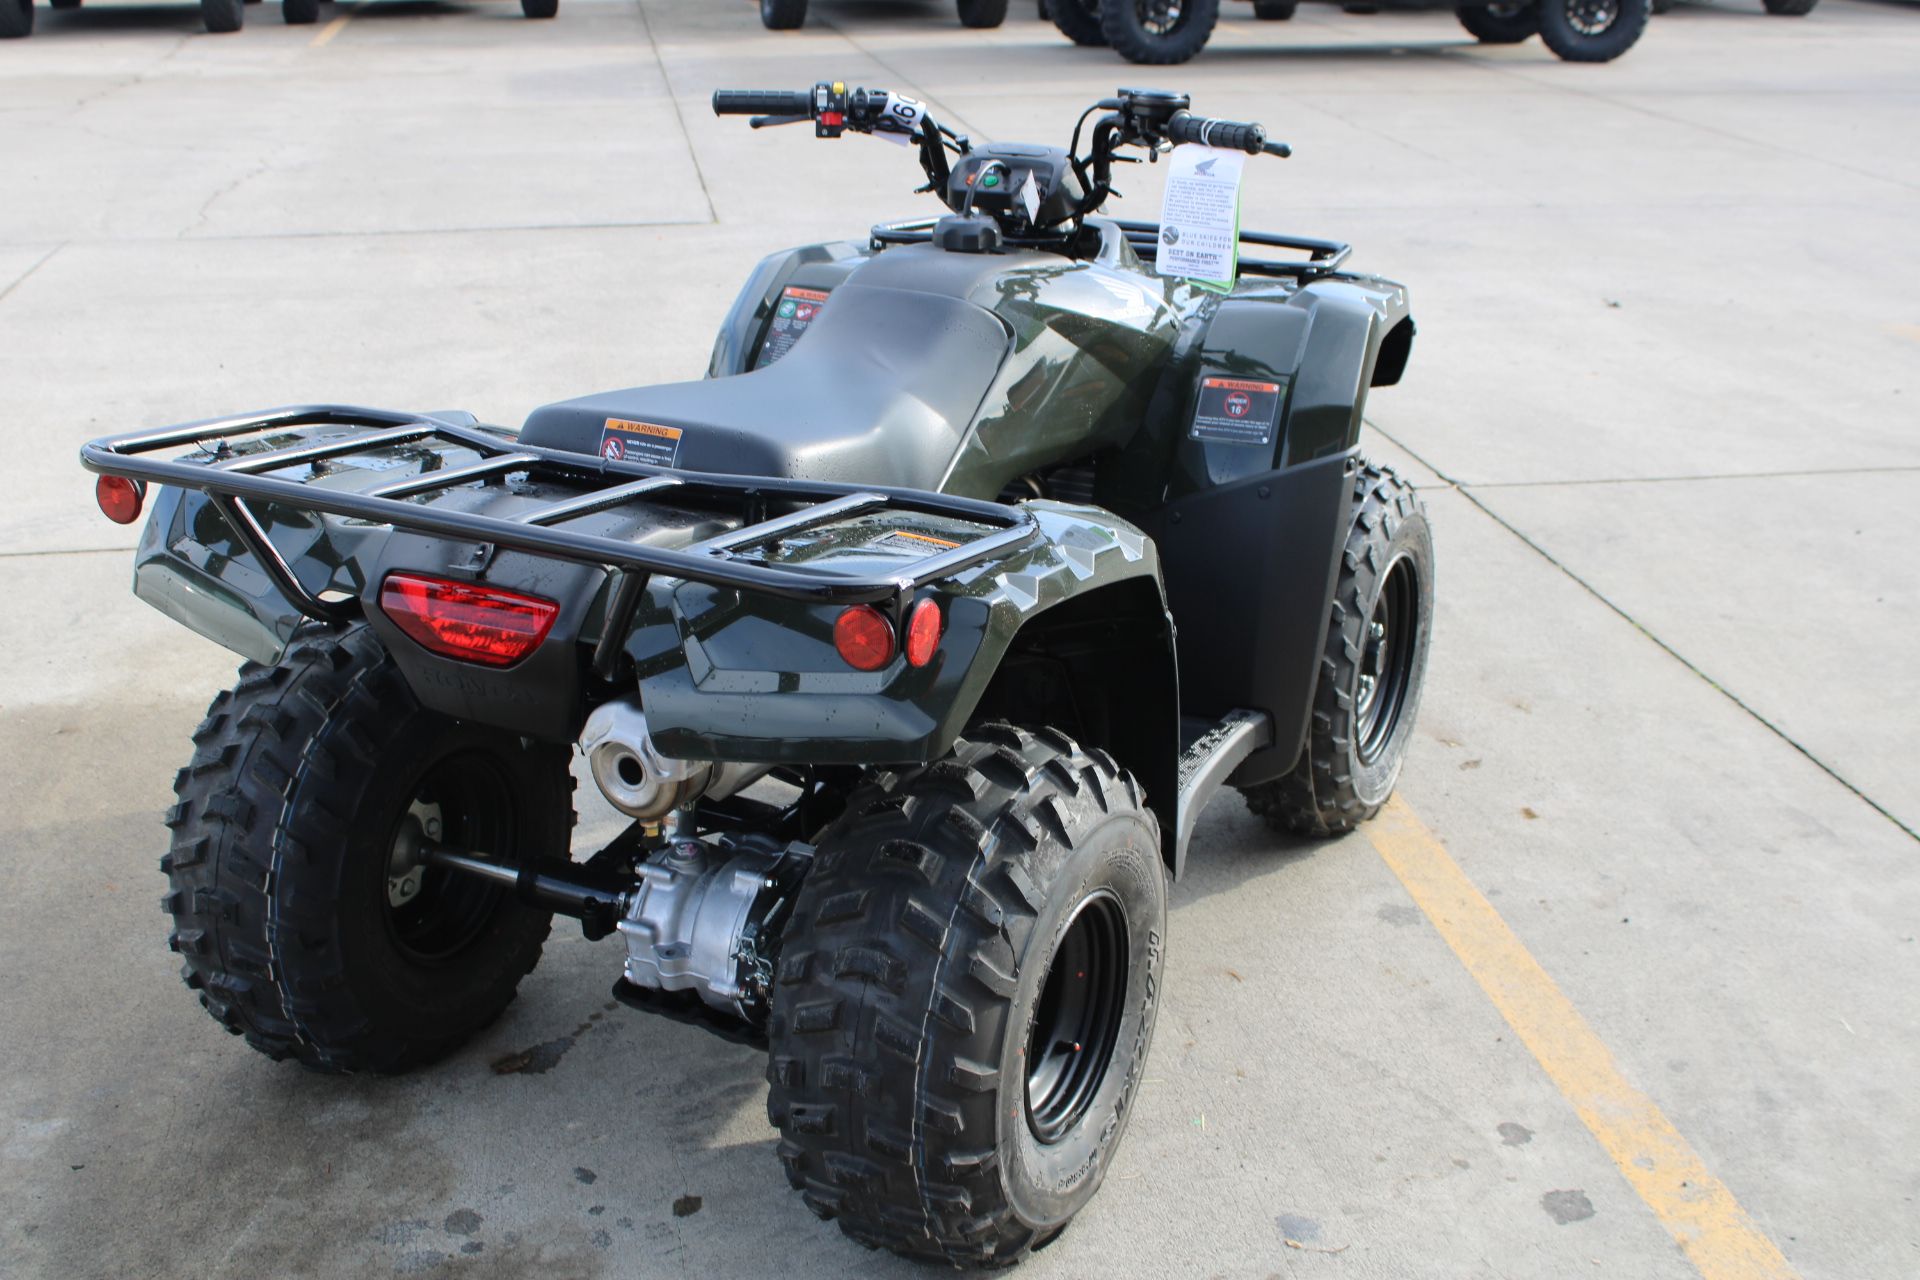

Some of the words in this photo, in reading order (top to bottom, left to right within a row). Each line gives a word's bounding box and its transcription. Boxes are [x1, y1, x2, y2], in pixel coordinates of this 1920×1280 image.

[1228, 381, 1264, 391] WARNING
[1231, 405, 1241, 414] 16
[627, 423, 669, 435] WARNING
